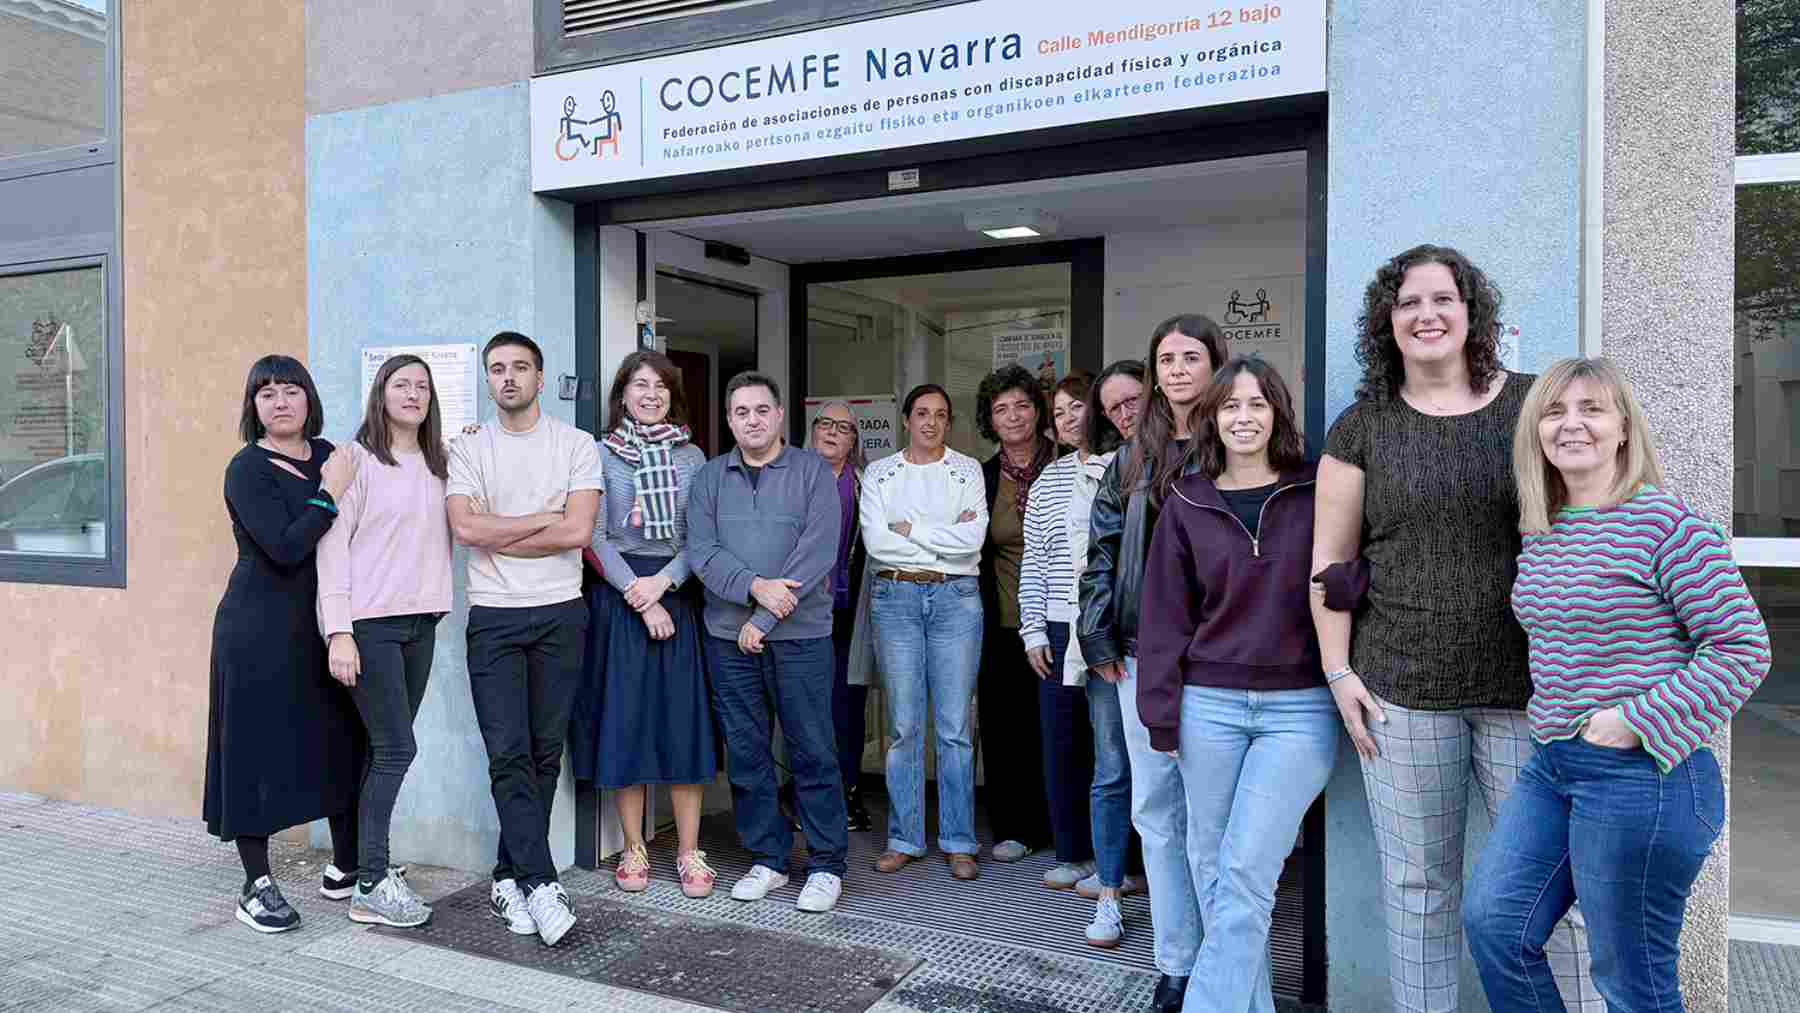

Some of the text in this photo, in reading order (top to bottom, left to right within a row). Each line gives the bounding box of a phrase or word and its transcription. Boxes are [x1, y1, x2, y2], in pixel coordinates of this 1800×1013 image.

[1038, 4, 1281, 54] Calle Mendigorría 12 bajo
[659, 32, 1022, 111] COCEMFE Navarra
[663, 40, 1282, 139] Federación de asociaciones de personas con discapacidad física y orgánica
[663, 64, 1281, 160] Nafarroako pertsona ezgaitu fisiko eta organikoen elkarteen federazioa
[1223, 327, 1281, 340] OCEMFE
[859, 418, 890, 431] RADA
